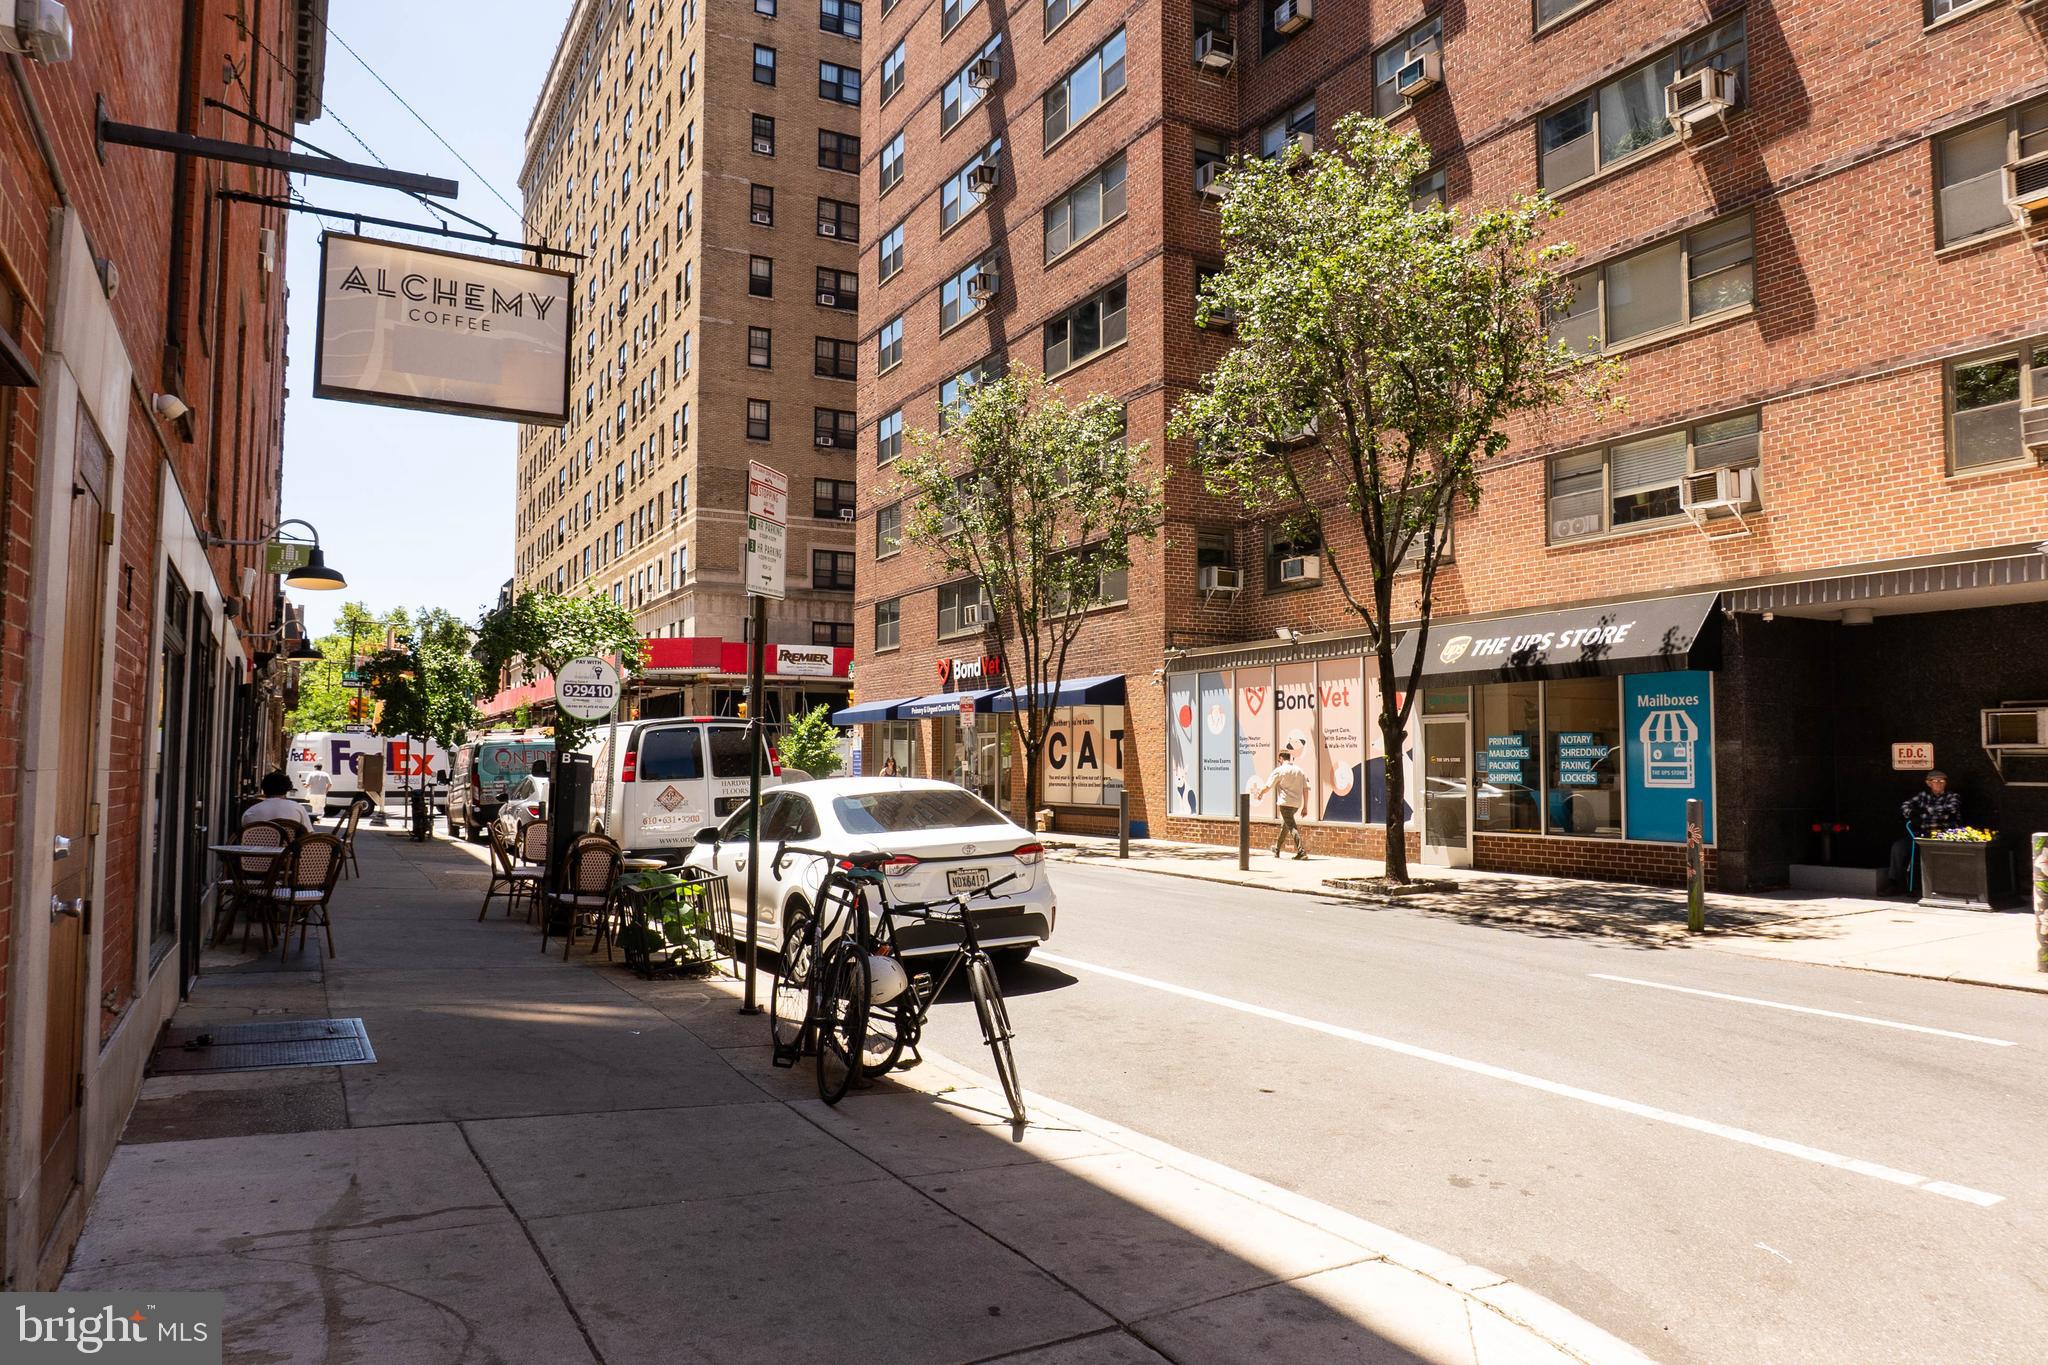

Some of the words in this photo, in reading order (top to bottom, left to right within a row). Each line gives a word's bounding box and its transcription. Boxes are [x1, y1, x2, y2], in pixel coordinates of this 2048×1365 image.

[340, 266, 555, 320] ALCHEMY
[409, 308, 491, 332] COFFEE
[759, 486, 779, 504] STOPPING
[764, 522, 783, 537] PARKING
[765, 544, 782, 559] PARKING
[1471, 637, 1511, 657] THE
[1511, 632, 1555, 652] UPS
[1556, 625, 1631, 649] STORE
[778, 649, 832, 666] PREMIER
[565, 685, 611, 697] 929410
[1318, 687, 1349, 708] Vet
[1637, 694, 1699, 707] Mailboxes
[1050, 719, 1068, 727] hether
[1069, 719, 1082, 728] yu're
[1560, 735, 1591, 744] NOTARY
[290, 748, 316, 762] FedEx
[1049, 730, 1124, 770] CAT
[1489, 749, 1528, 757] MAILBOXES
[1561, 748, 1607, 757] SHREDDING
[1899, 748, 1926, 758] F.D.C.
[562, 753, 571, 763] B
[1489, 761, 1519, 769] PACKING
[1561, 761, 1590, 769] FAXING
[1489, 774, 1521, 782] SHIPPING
[1561, 774, 1596, 783] LOCKERS
